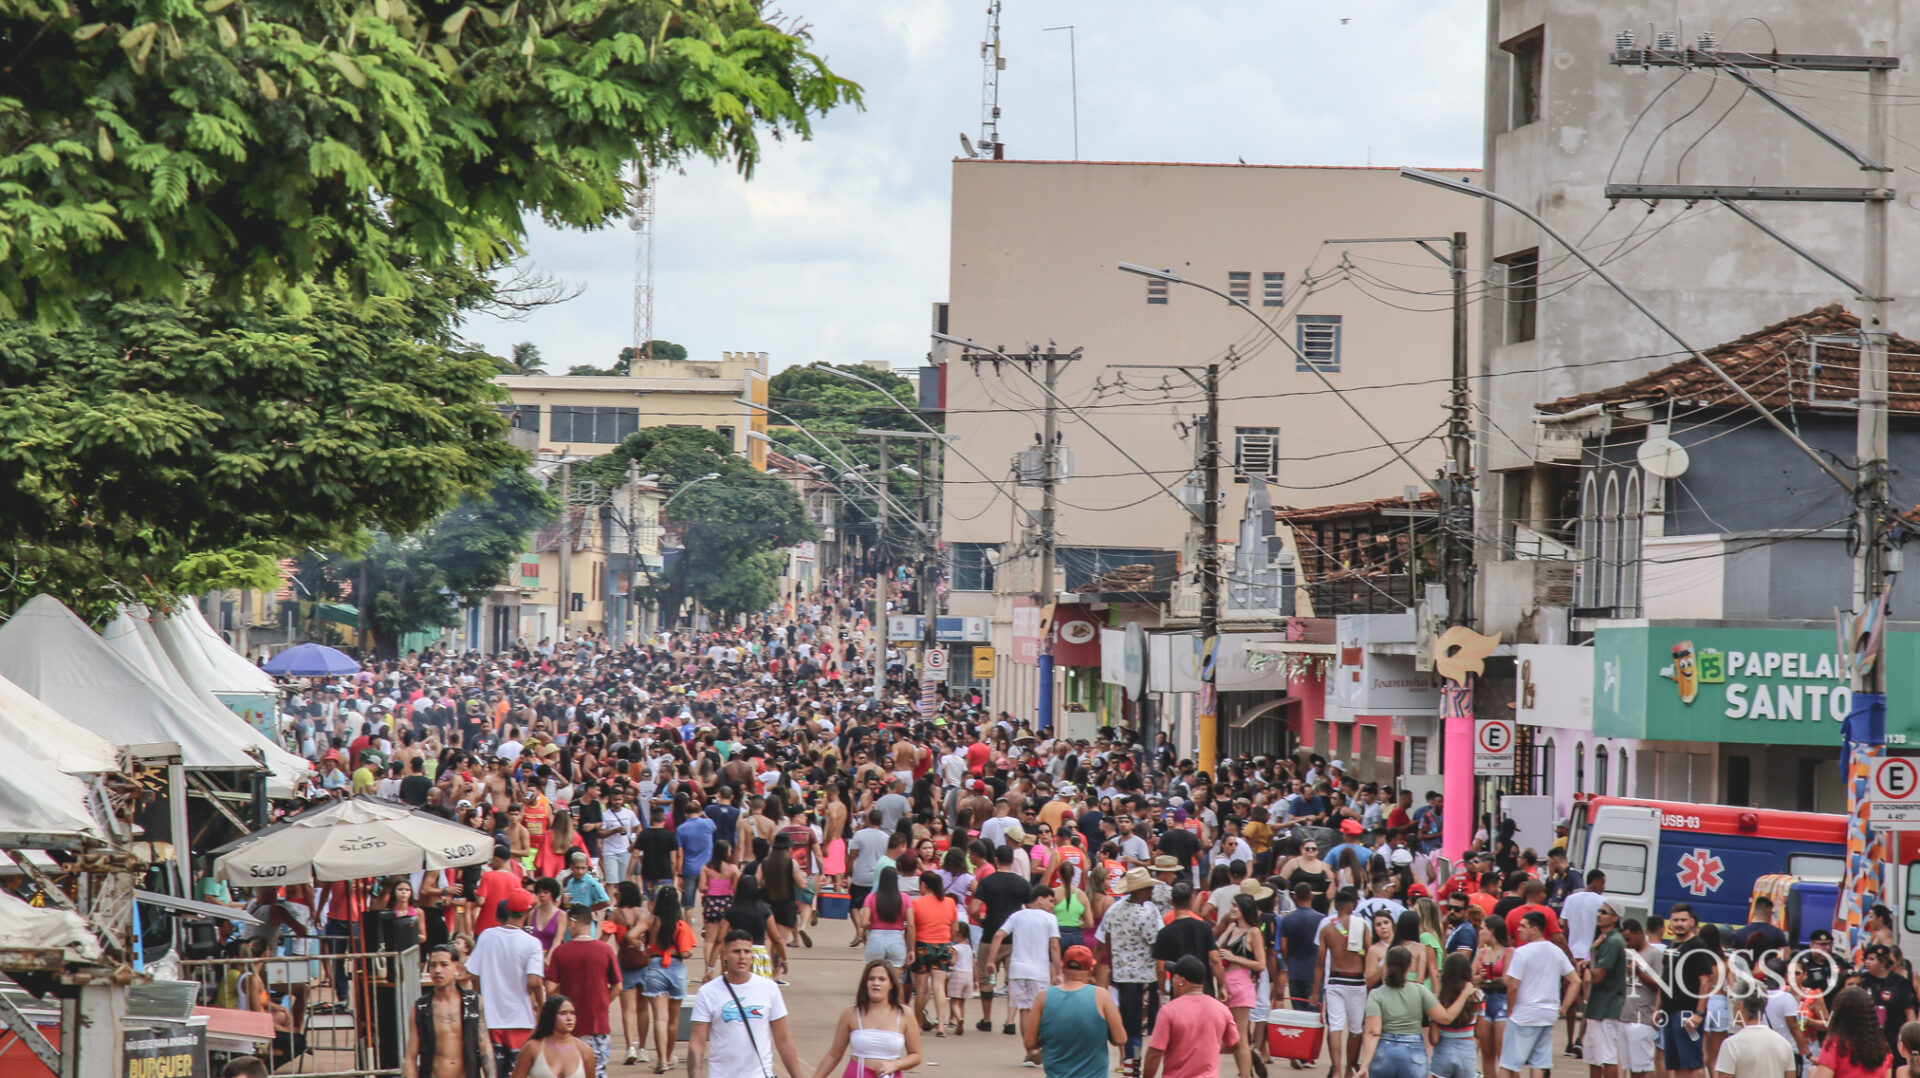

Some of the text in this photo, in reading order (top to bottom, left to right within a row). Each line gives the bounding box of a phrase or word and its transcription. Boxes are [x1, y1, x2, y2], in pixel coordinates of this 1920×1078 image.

[932, 654, 940, 664] E
[1489, 728, 1501, 746] E
[1889, 766, 1904, 790] E
[1661, 813, 1701, 829] USB-03
[129, 1054, 193, 1078] BURGUER
